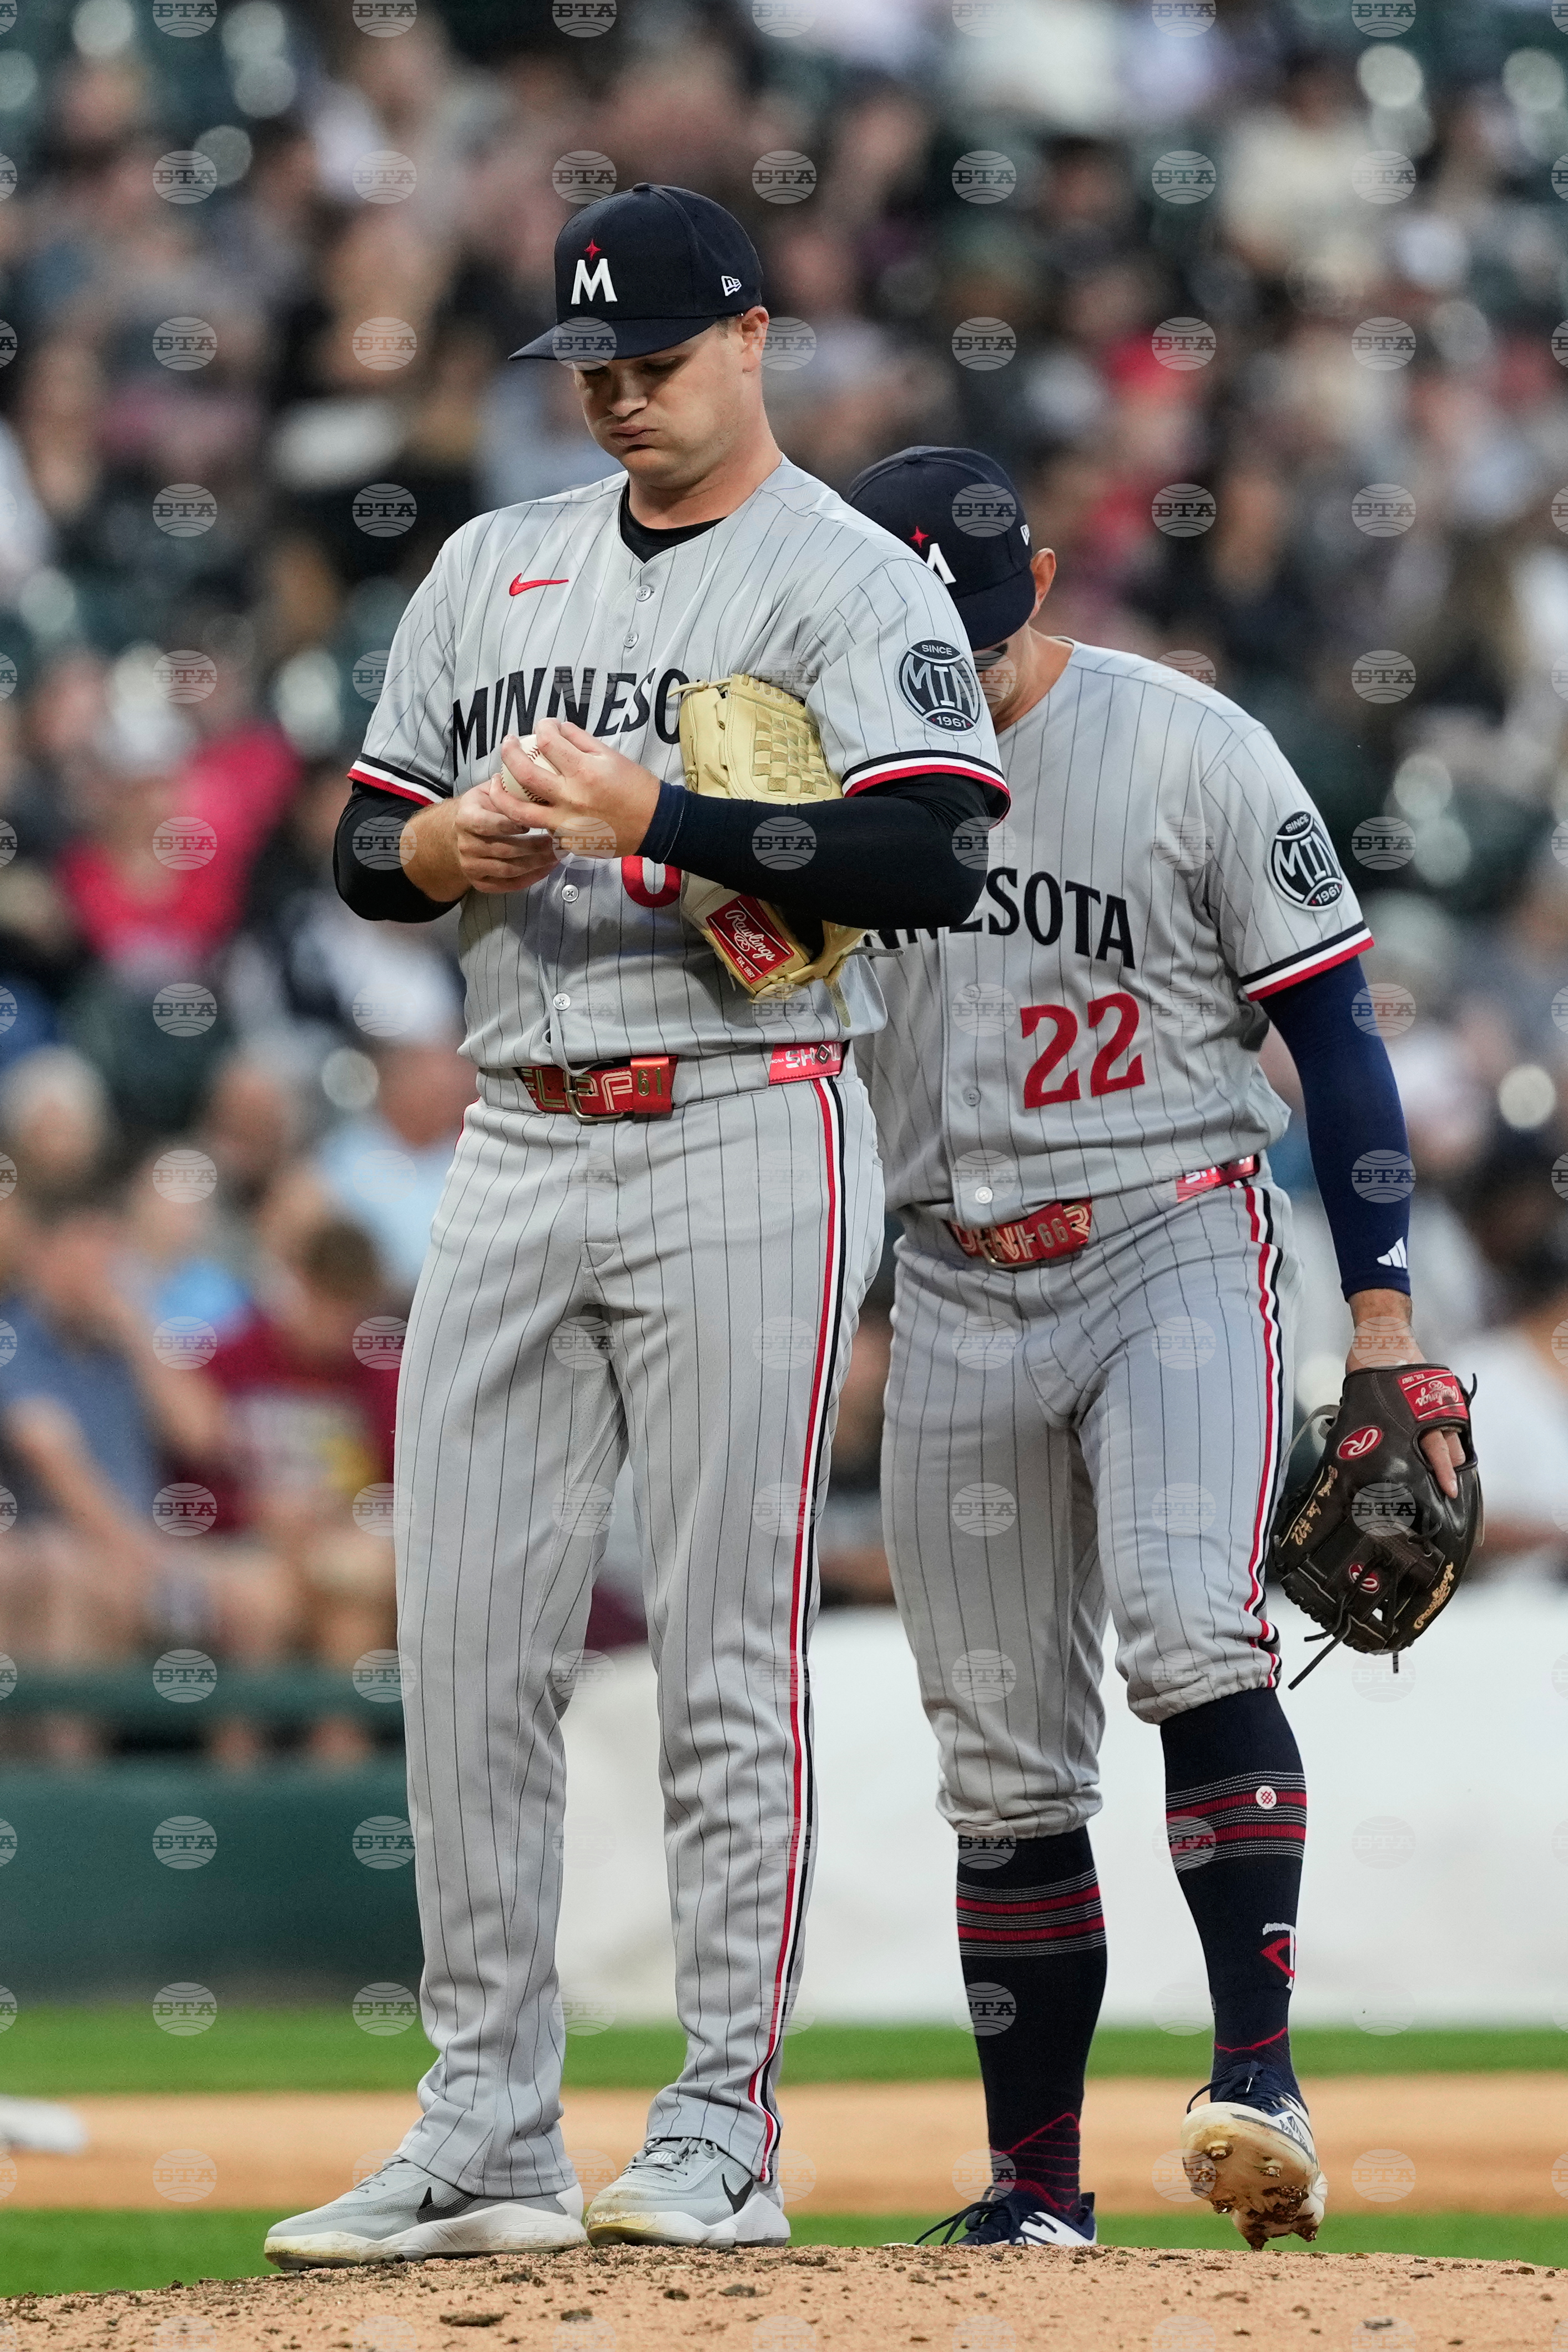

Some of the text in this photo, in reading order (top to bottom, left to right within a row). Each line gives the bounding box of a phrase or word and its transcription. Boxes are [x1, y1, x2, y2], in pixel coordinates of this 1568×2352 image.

[571, 258, 618, 305] M
[921, 644, 953, 656] SINCE
[902, 654, 979, 721] MIN
[453, 666, 700, 780] MINNESO
[936, 716, 967, 729] 1961
[1285, 814, 1309, 833] SINCE
[1273, 822, 1340, 900] MIN
[1315, 884, 1340, 905] 1961
[725, 909, 777, 961] Rawlings
[736, 956, 756, 978] Est. 1887
[1020, 991, 1146, 1109] 22
[637, 1067, 663, 1097] 61
[1037, 1218, 1069, 1248] 66
